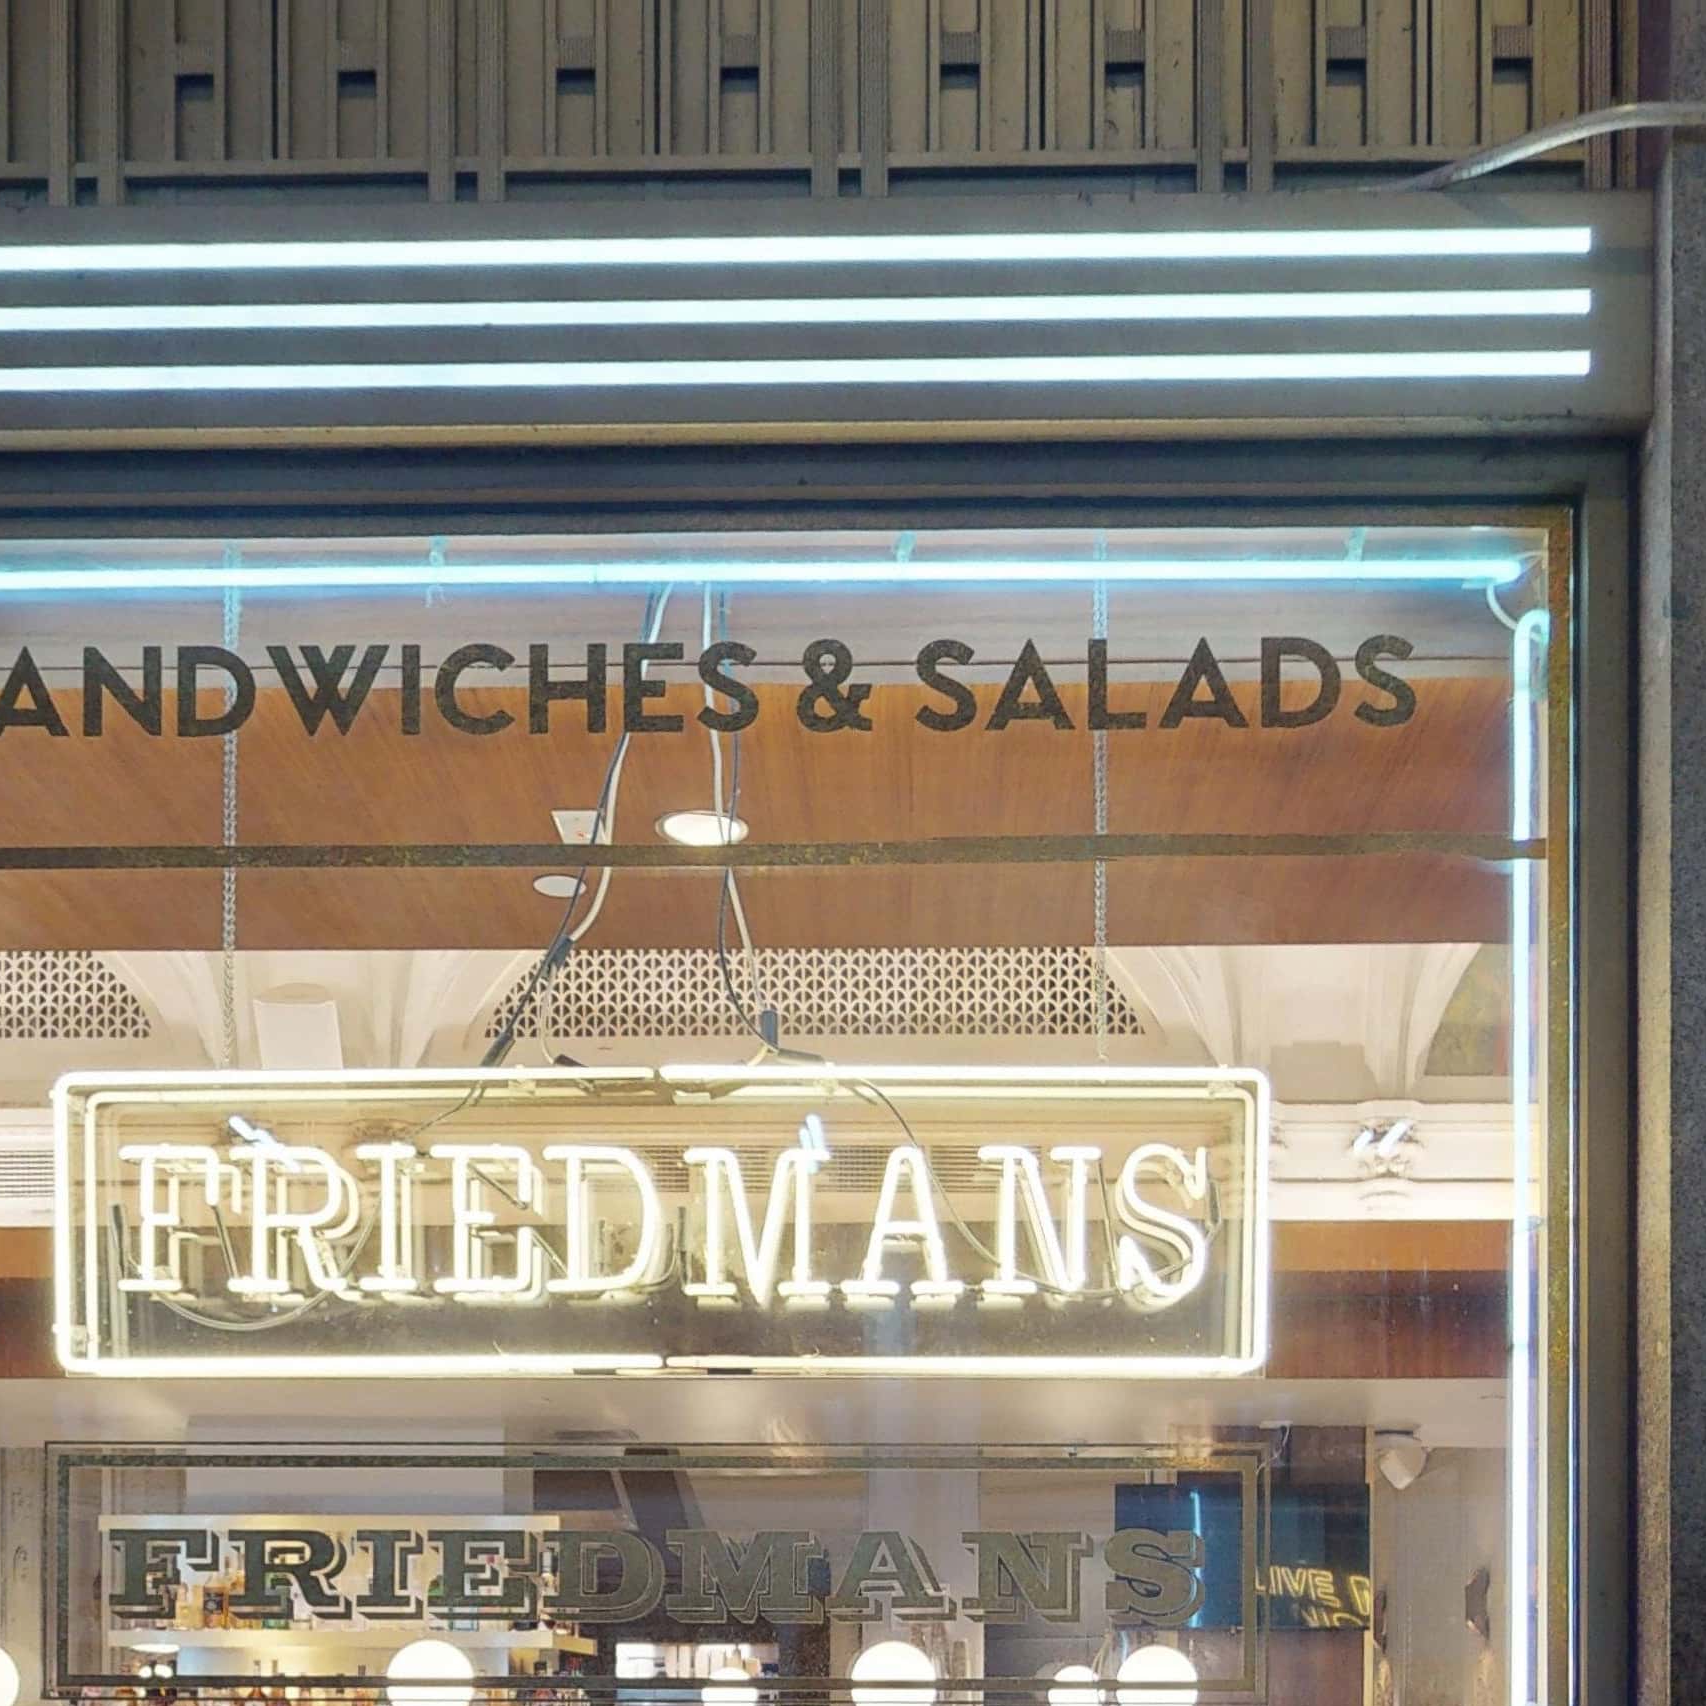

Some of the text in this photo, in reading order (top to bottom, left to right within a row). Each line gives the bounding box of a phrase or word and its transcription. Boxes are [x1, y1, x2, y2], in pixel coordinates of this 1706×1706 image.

[796, 638, 872, 733] &
[915, 634, 1416, 731] SALADS
[117, 1142, 1210, 1307] FRIEDMANS
[108, 1526, 1206, 1626] FRIEDMANS
